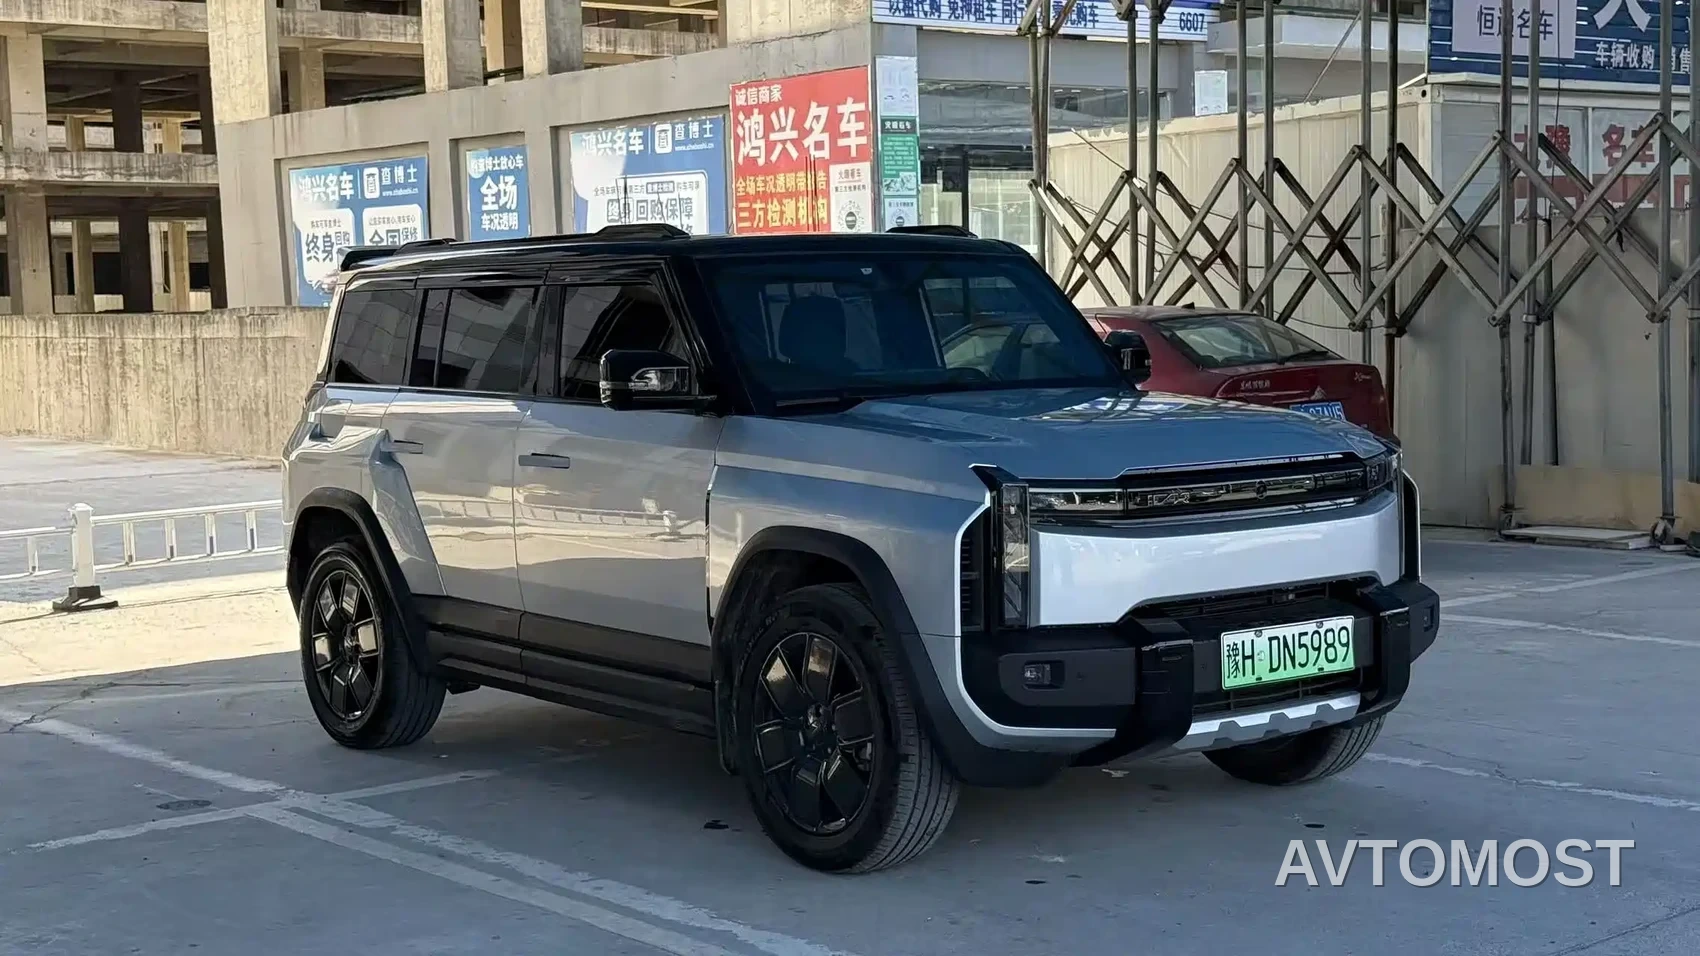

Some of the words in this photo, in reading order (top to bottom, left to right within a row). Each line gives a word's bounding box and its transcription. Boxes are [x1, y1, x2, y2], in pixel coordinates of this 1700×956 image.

[1179, 12, 1206, 32] 6607
[1595, 41, 1655, 70] 车辆收购
[1669, 46, 1691, 75] 售
[735, 84, 783, 106] 诚信商家
[581, 128, 645, 157] 鸿兴名车
[674, 120, 715, 141] 查博士
[736, 97, 868, 167] 鸿兴名车
[297, 171, 354, 203] 鸿兴名车
[381, 163, 418, 187] 查博士
[479, 174, 518, 211] 全场
[480, 212, 519, 232] 车况透明
[737, 195, 828, 228] 三方检测机构
[1268, 626, 1350, 673] DN5989
